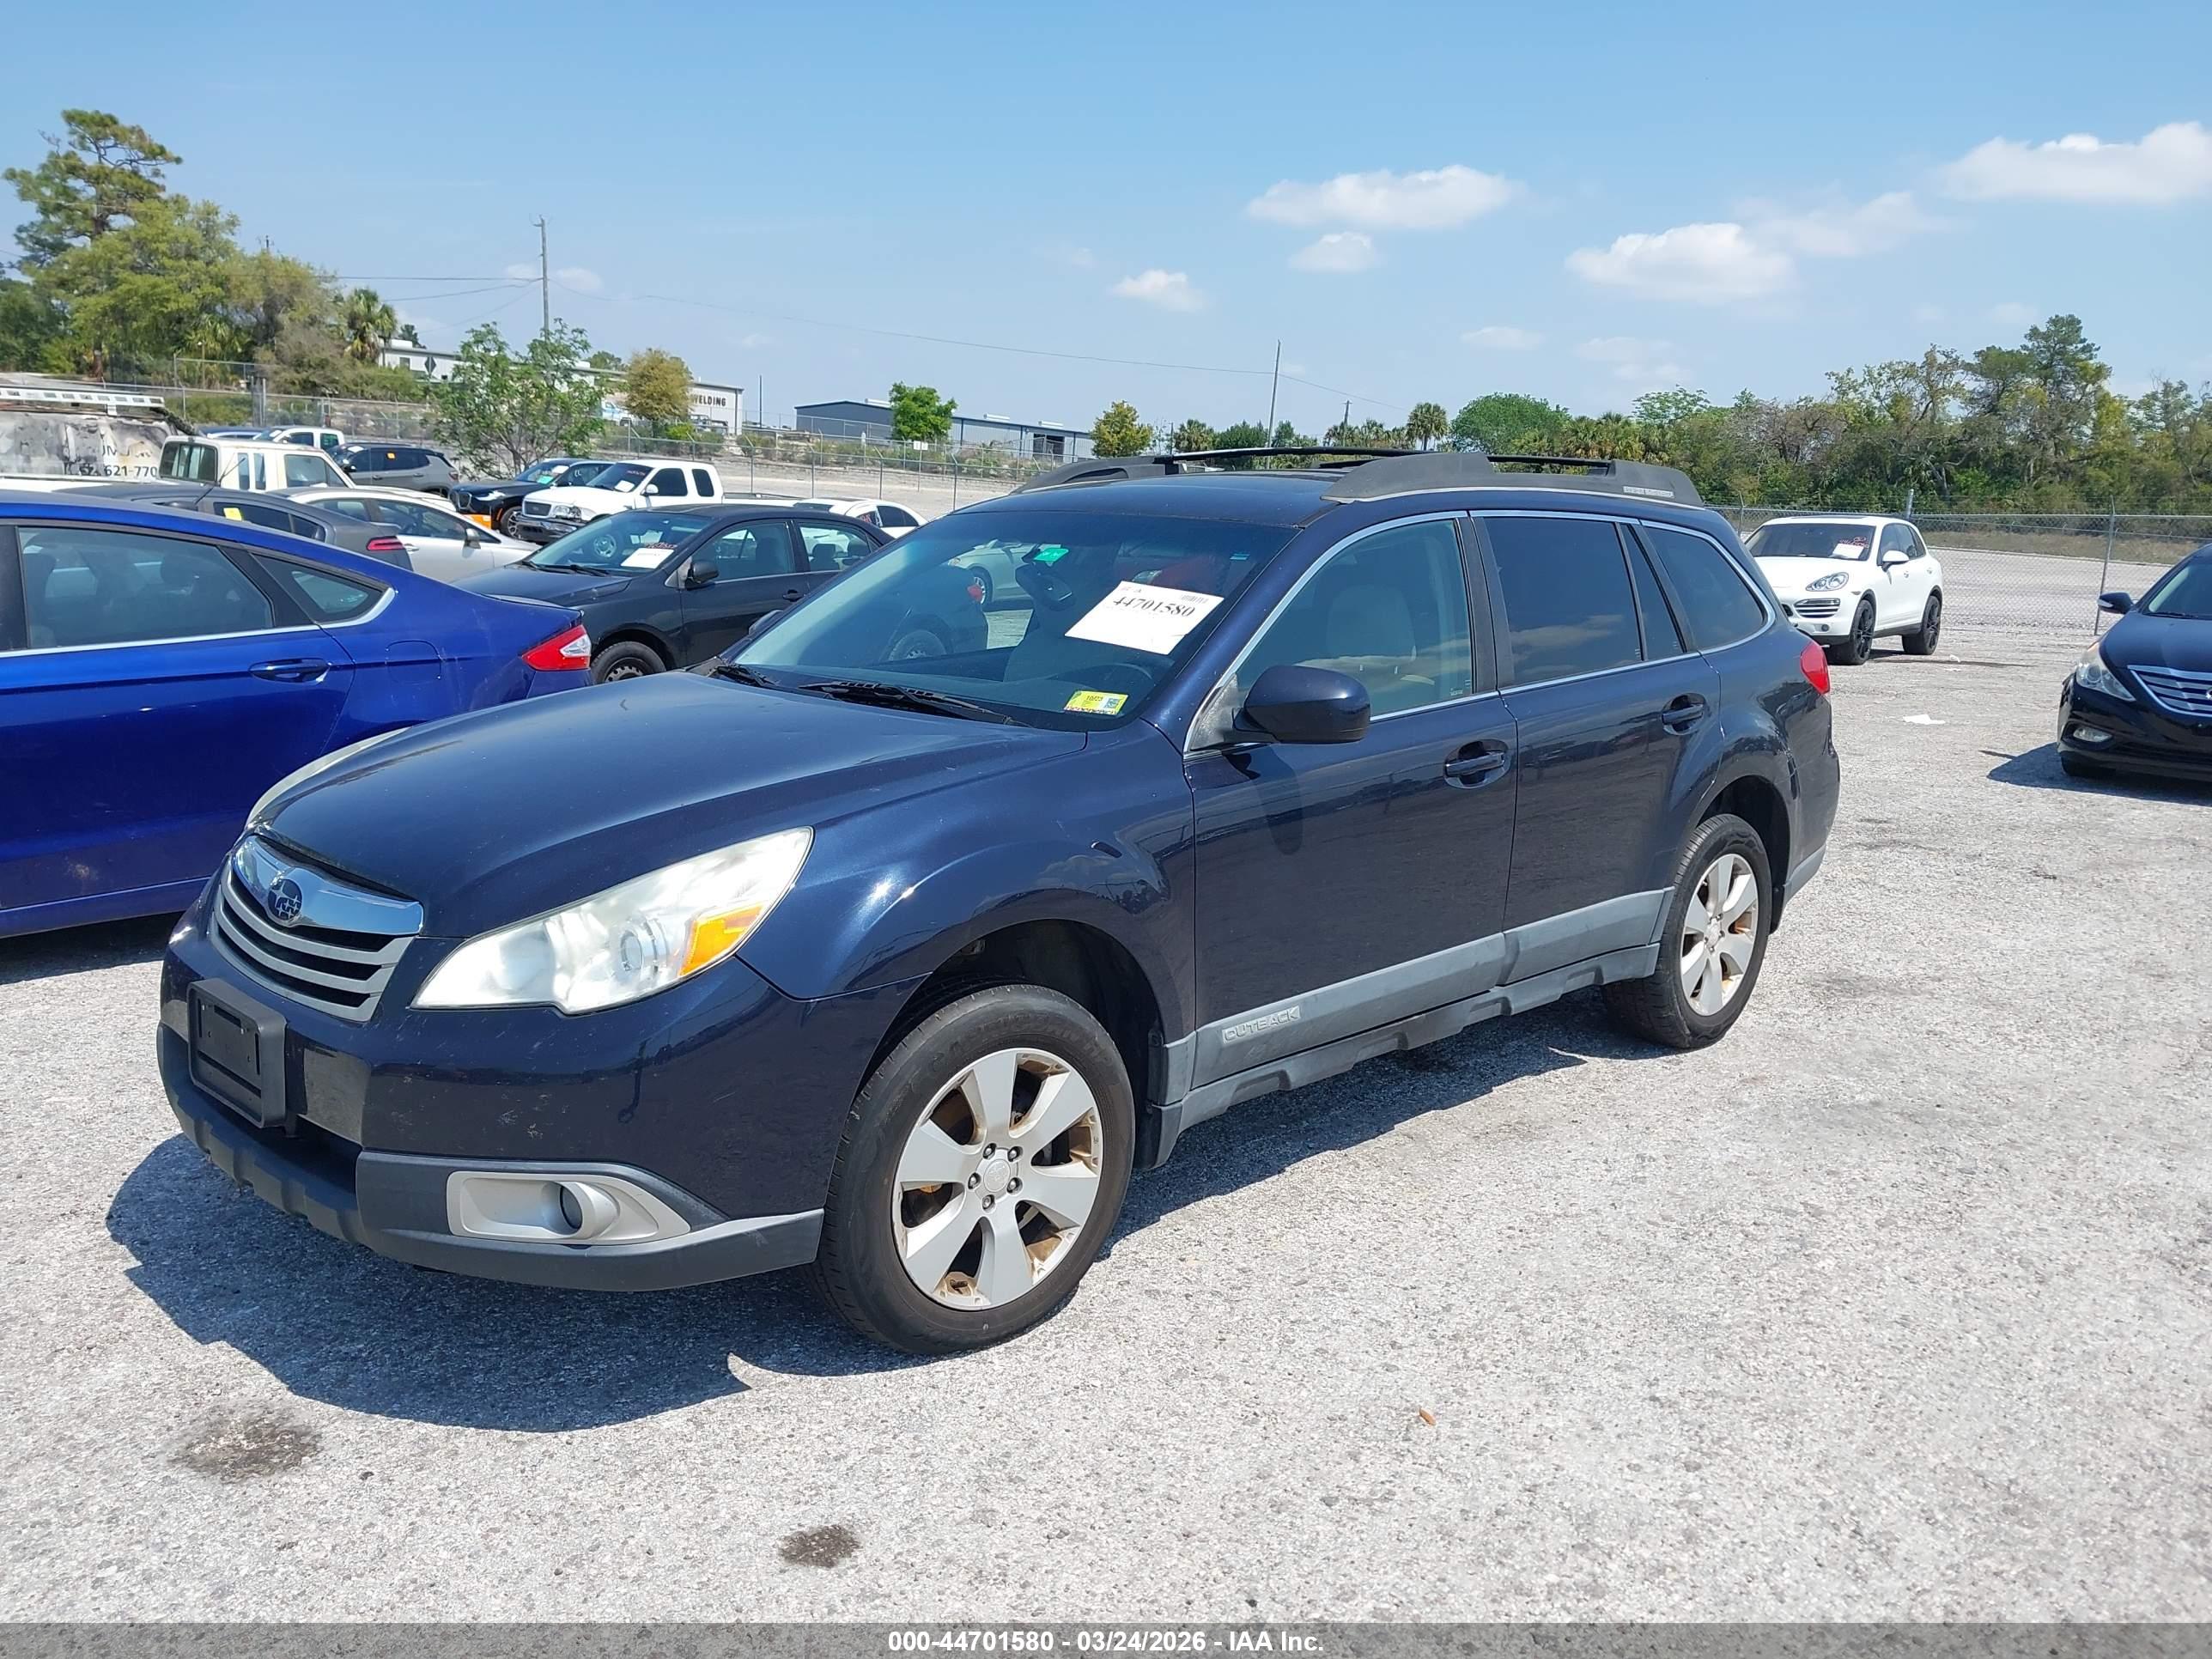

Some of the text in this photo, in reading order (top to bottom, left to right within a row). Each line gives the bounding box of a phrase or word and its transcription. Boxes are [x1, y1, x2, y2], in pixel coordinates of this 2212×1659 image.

[690, 394, 726, 407] WELDING
[1113, 596, 1195, 617] 44701580
[1224, 1007, 1299, 1042] OUTBACK
